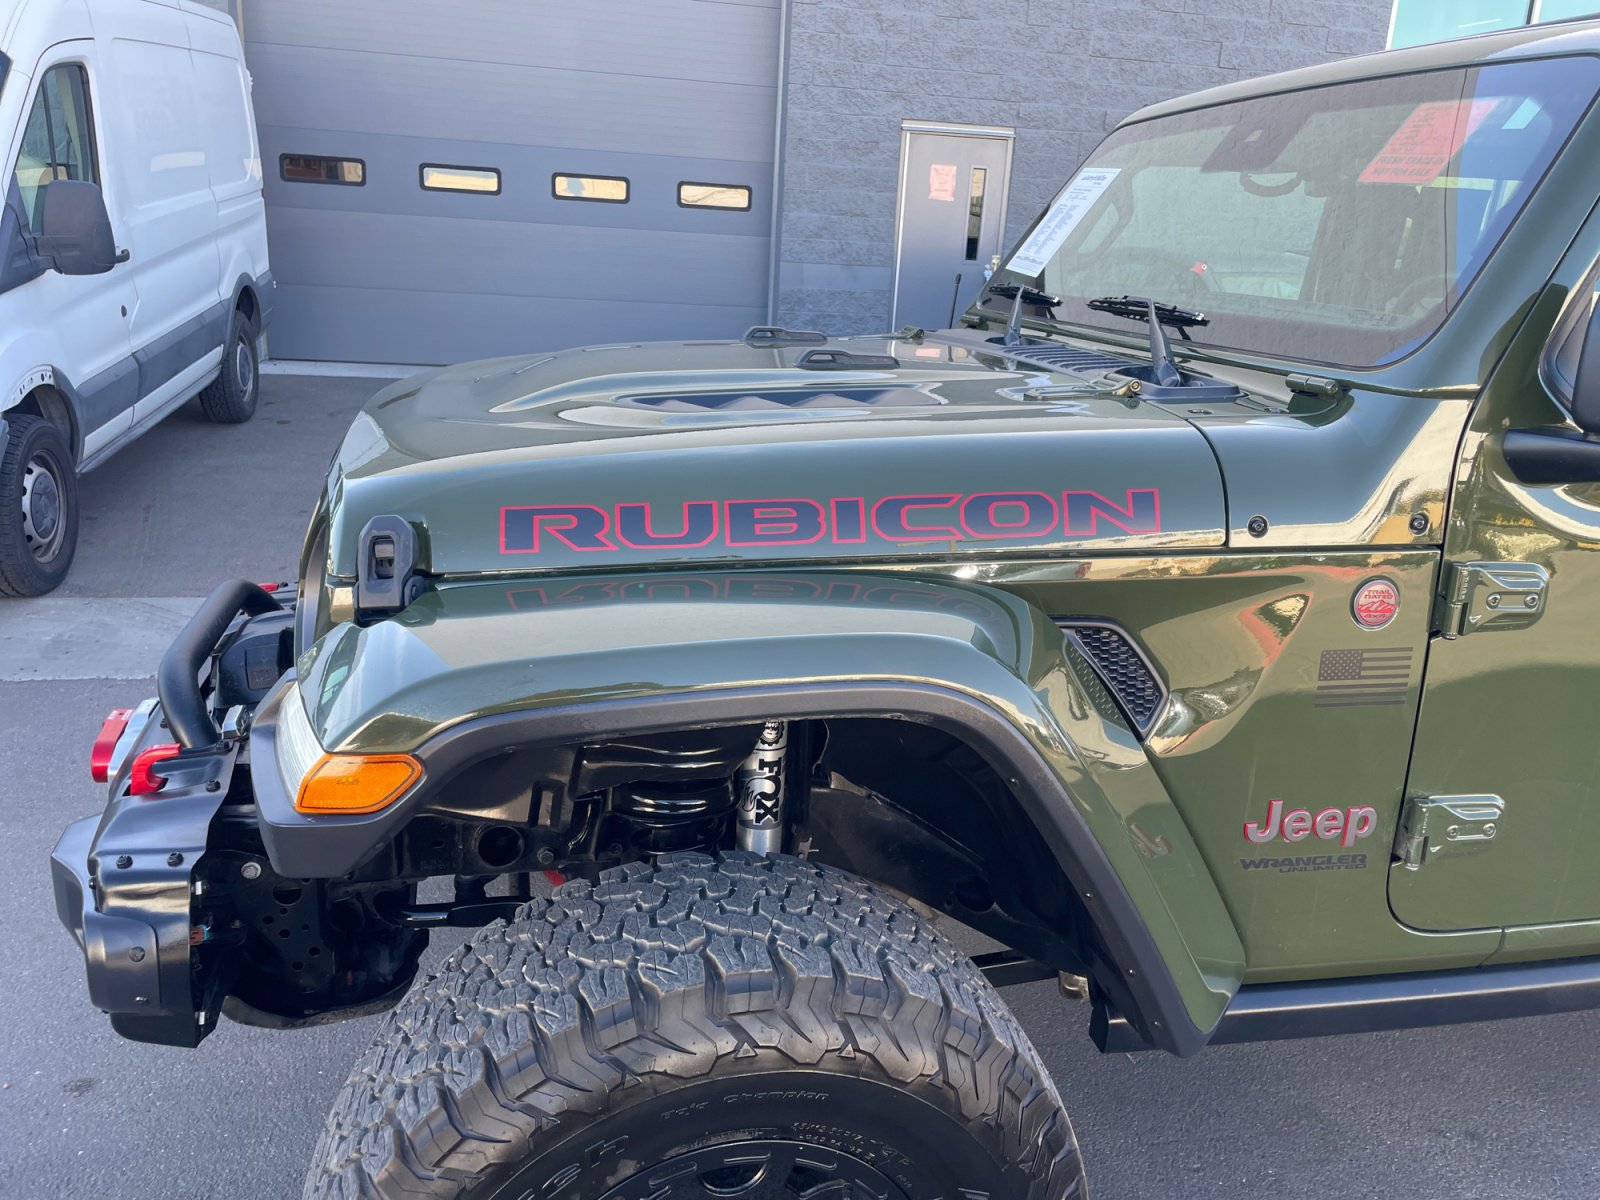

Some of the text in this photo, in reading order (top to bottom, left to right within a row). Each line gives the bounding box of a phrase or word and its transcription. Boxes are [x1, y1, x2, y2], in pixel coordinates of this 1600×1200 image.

[500, 487, 1162, 555] RUBICON
[743, 758, 782, 825] FOX
[1243, 799, 1378, 848] Jeep
[1239, 853, 1368, 870] WRANGLER
[1279, 863, 1367, 874] UNLIMITED
